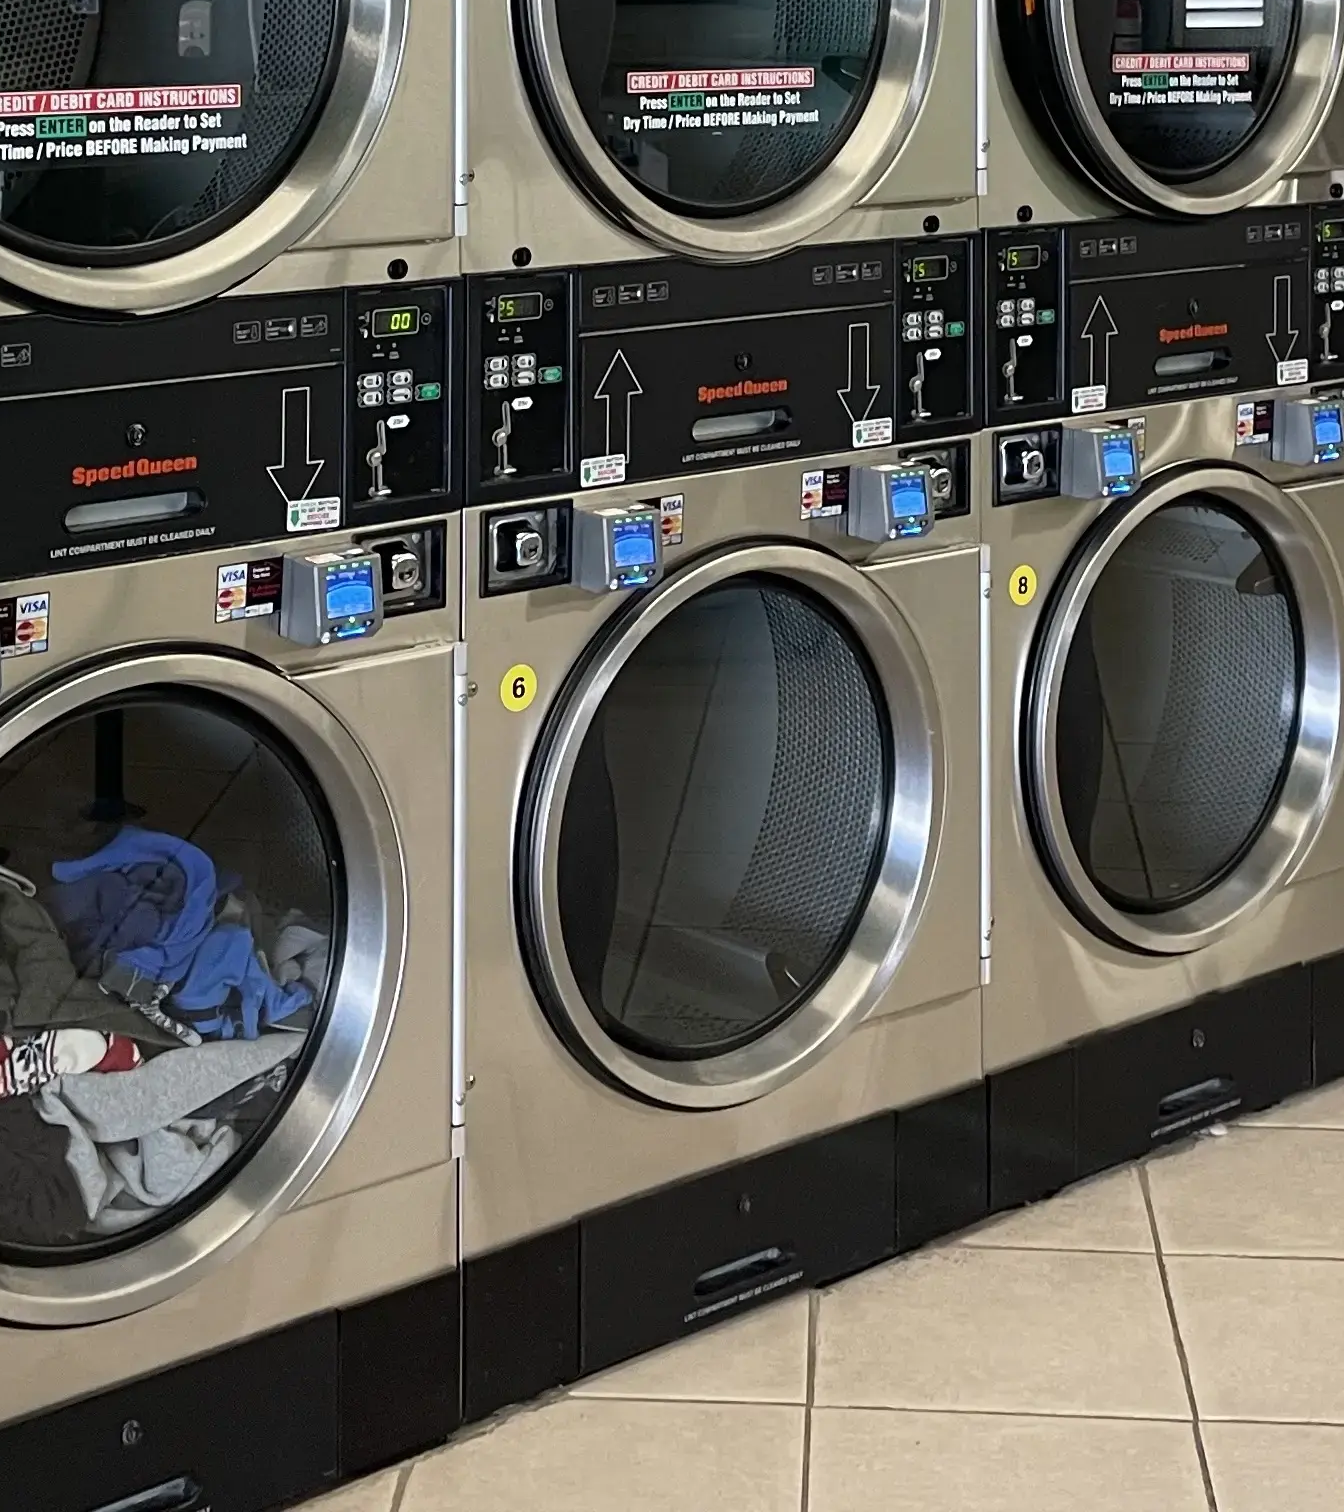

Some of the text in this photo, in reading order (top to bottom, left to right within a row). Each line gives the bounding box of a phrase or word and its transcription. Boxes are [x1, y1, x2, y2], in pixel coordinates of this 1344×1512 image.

[631, 75, 669, 90] CREDIT
[679, 74, 708, 88] DEBIT
[711, 73, 739, 87] CARD
[741, 70, 811, 86] INSTRUCTIONS
[50, 93, 92, 111] DEBIT
[96, 91, 134, 109] CARD
[138, 88, 237, 108] INSTRUCTIONS
[640, 91, 800, 110] Press ENTER on the Reader to Set
[39, 118, 85, 136] ENTER
[89, 120, 106, 133] on
[109, 117, 131, 133] the
[135, 116, 181, 132] Reader
[184, 115, 198, 130] to
[200, 113, 221, 129] Set
[623, 117, 640, 133] Dry
[642, 115, 668, 129] Time
[675, 114, 701, 127] Price
[703, 112, 740, 126] BEFORE
[742, 111, 777, 127] Making
[779, 109, 819, 125] Payment
[0, 144, 34, 160] Time
[45, 142, 82, 158] Price
[85, 139, 137, 156] BEFORE
[141, 138, 189, 156] Making
[192, 134, 247, 152] Payment
[390, 313, 411, 330] 00
[805, 475, 822, 486] VISA
[662, 500, 682, 512] VISA
[50, 526, 216, 559] LINT COMPARTMENT MUST BE CLEANED DAILY
[222, 569, 245, 583] VISA
[1018, 576, 1028, 594] 8
[20, 600, 47, 614] VISA
[512, 677, 525, 698] 6
